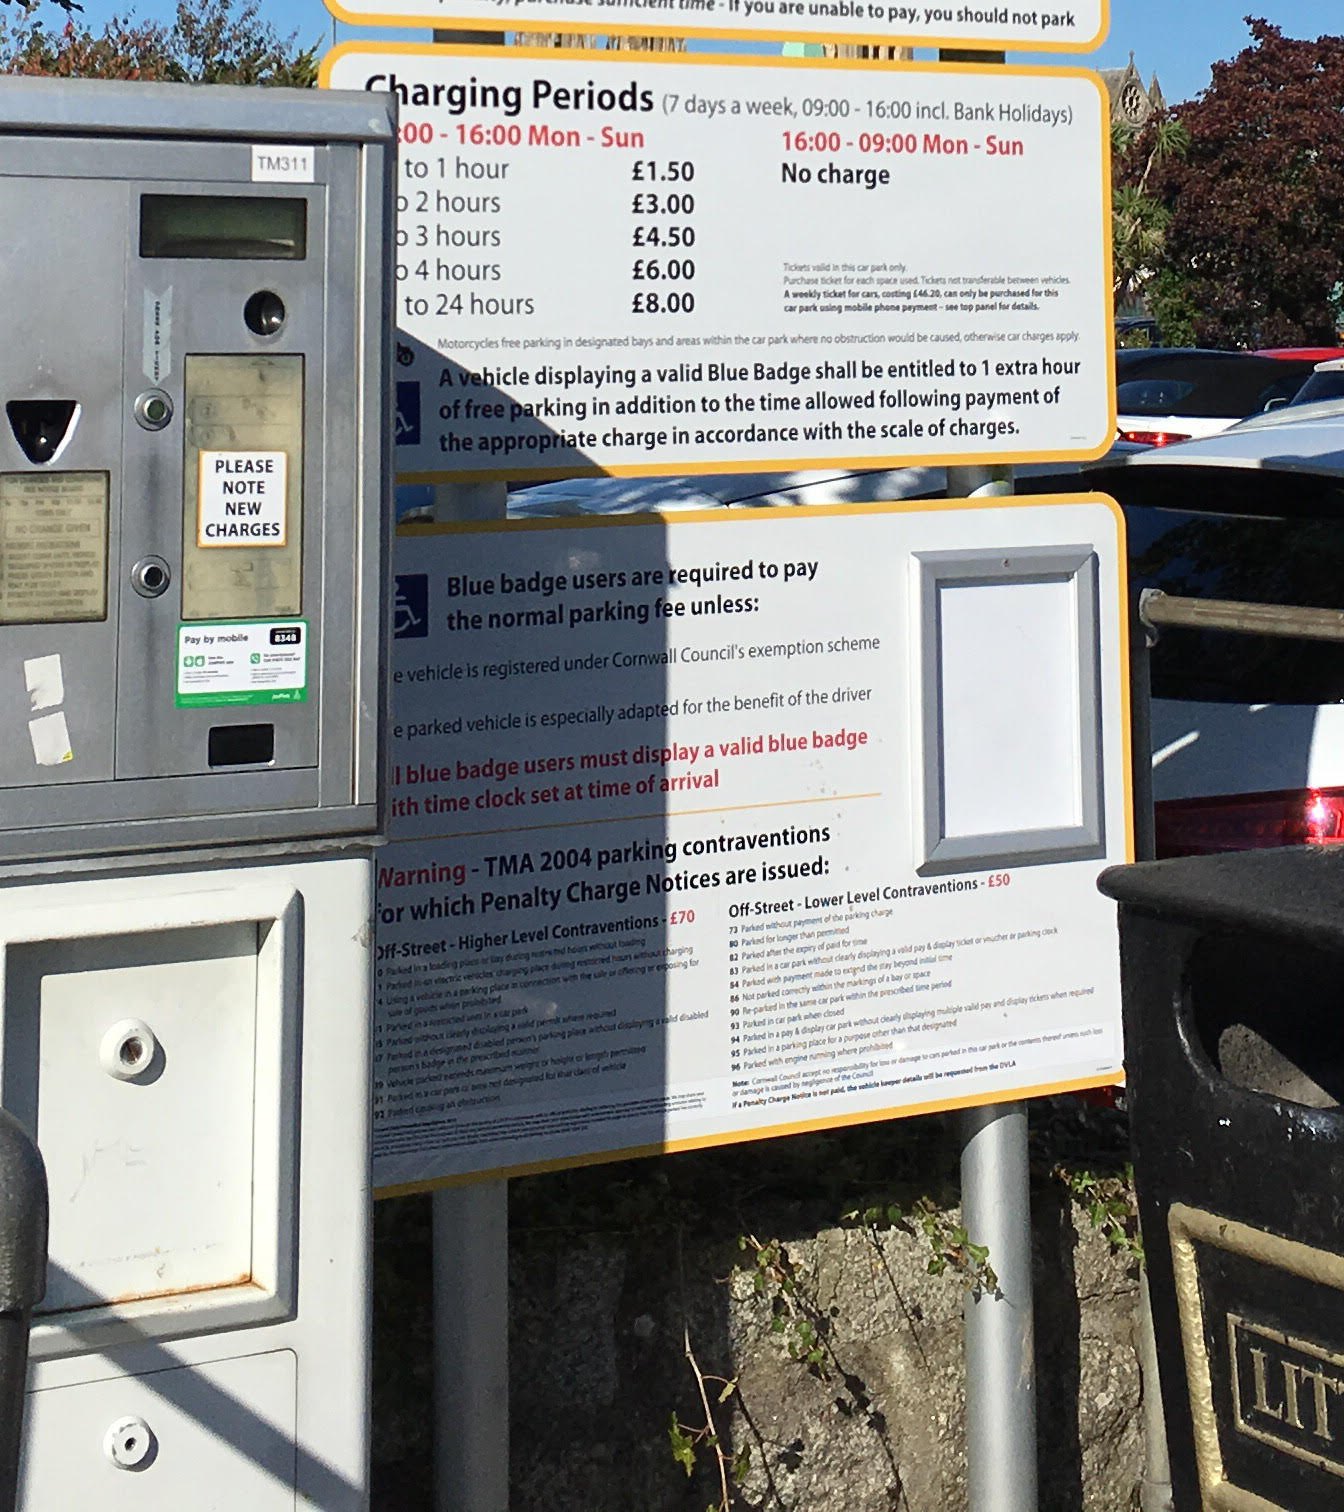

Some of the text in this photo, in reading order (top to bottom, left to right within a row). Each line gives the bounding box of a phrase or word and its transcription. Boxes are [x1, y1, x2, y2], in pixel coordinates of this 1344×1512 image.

[743, 0, 775, 14] you
[778, 1, 805, 16] are
[808, 0, 865, 18] unable
[867, 3, 885, 19] to
[888, 6, 921, 24] pay,
[924, 8, 953, 24] you
[956, 5, 1009, 24] should
[1012, 11, 1038, 26] not
[1041, 10, 1076, 29] park
[364, 73, 654, 117] Charging Periods
[662, 93, 1073, 128] (7 days a week, 09:00 16:00 incl. Bank Holidays)
[455, 123, 645, 149] 16:00 Mon Sun
[782, 130, 1024, 156] 16:00 09:00 Mon Sun
[257, 155, 307, 171] TM311
[404, 155, 510, 180] to 1 hour
[631, 160, 695, 182] £1.50
[781, 162, 891, 190] No charge
[415, 190, 501, 214] 2 hours
[631, 193, 695, 215] £3.00
[415, 223, 501, 247] 3 hours
[632, 226, 696, 248] £4.50
[414, 257, 501, 281] 4 hours
[632, 258, 696, 281] £6.00
[404, 291, 535, 316] to 24 hours
[631, 291, 695, 314] £8.00
[438, 357, 1081, 390] A vehicle displaying a valid Blue Badge shall be entitled to 1 extra hour
[214, 459, 274, 475] PLEASE
[221, 480, 266, 495] NOTE
[224, 501, 263, 516] NEW
[205, 522, 281, 538] CHARGES
[447, 558, 819, 598] Blue badge users are required to pay
[184, 633, 249, 645] Pay by mobile
[483, 852, 535, 878] TMA
[540, 847, 593, 872] 2004
[596, 841, 677, 872] parking
[682, 826, 831, 856] contraventions
[728, 873, 1011, 919] Off-Street Lower Level Contraventions £50
